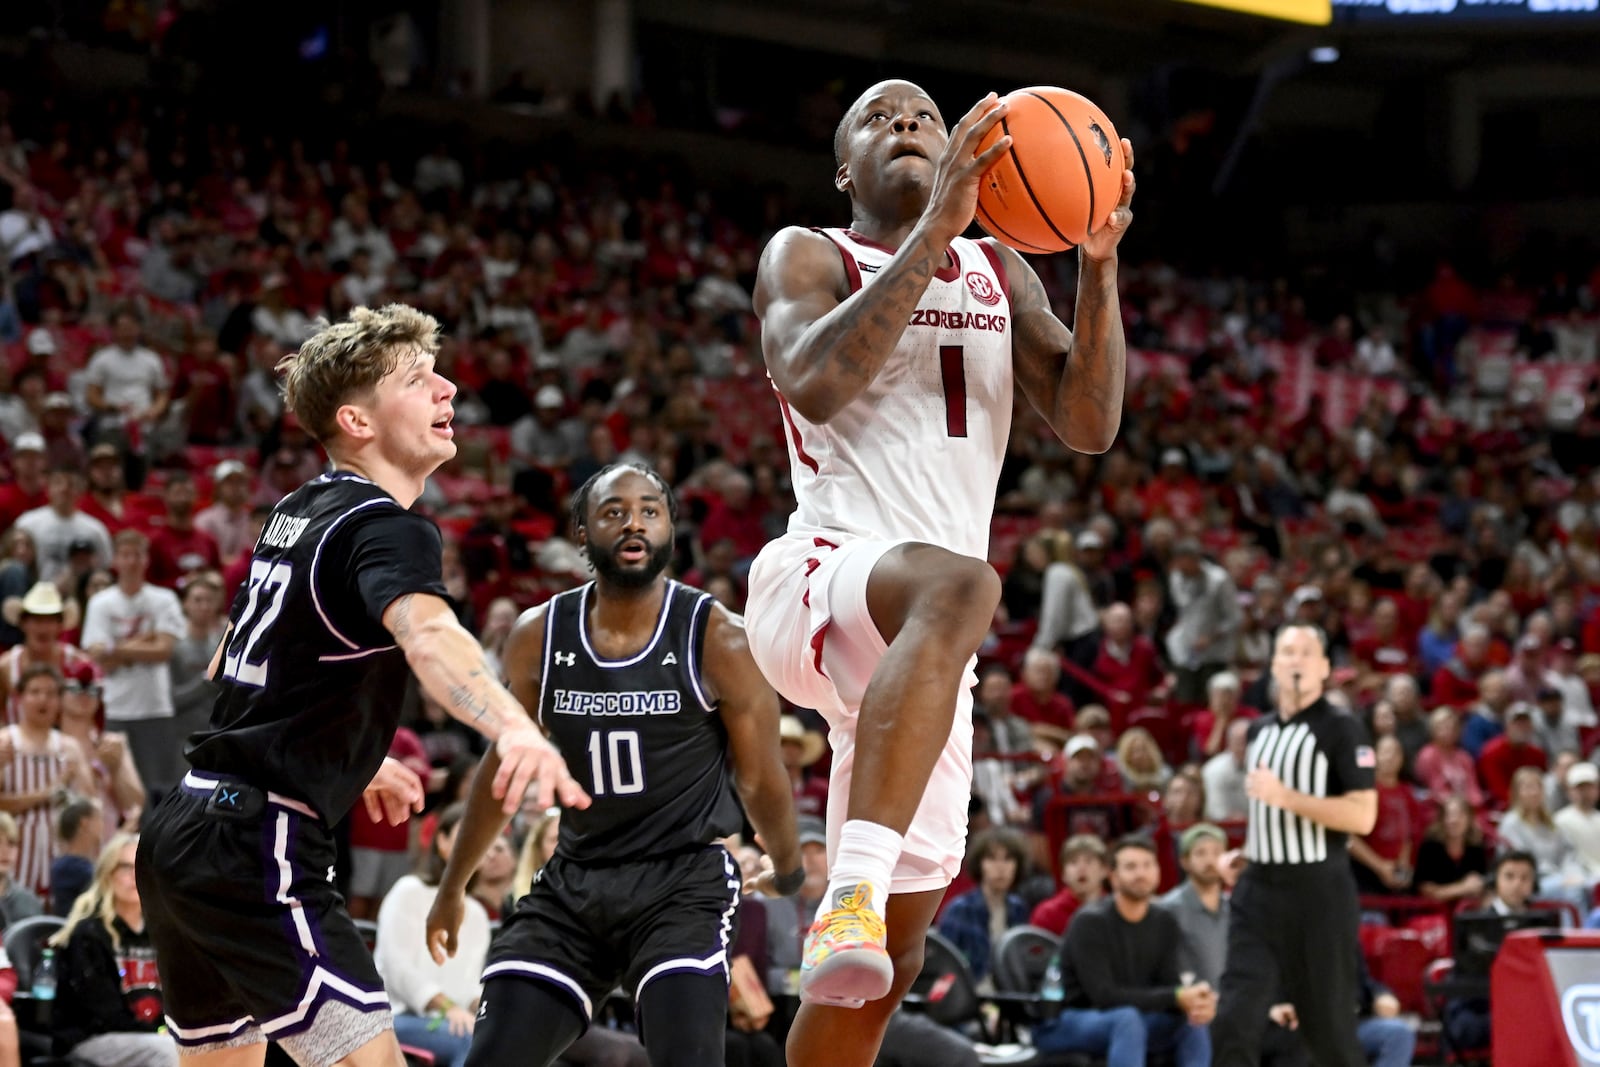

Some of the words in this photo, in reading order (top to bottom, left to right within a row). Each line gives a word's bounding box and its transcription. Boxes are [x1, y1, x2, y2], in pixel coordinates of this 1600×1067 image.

[908, 309, 1006, 333] ZORBACKS
[939, 345, 967, 437] 1
[222, 556, 292, 688] 22
[553, 689, 682, 716] LIPSCOMB
[588, 730, 644, 795] 10
